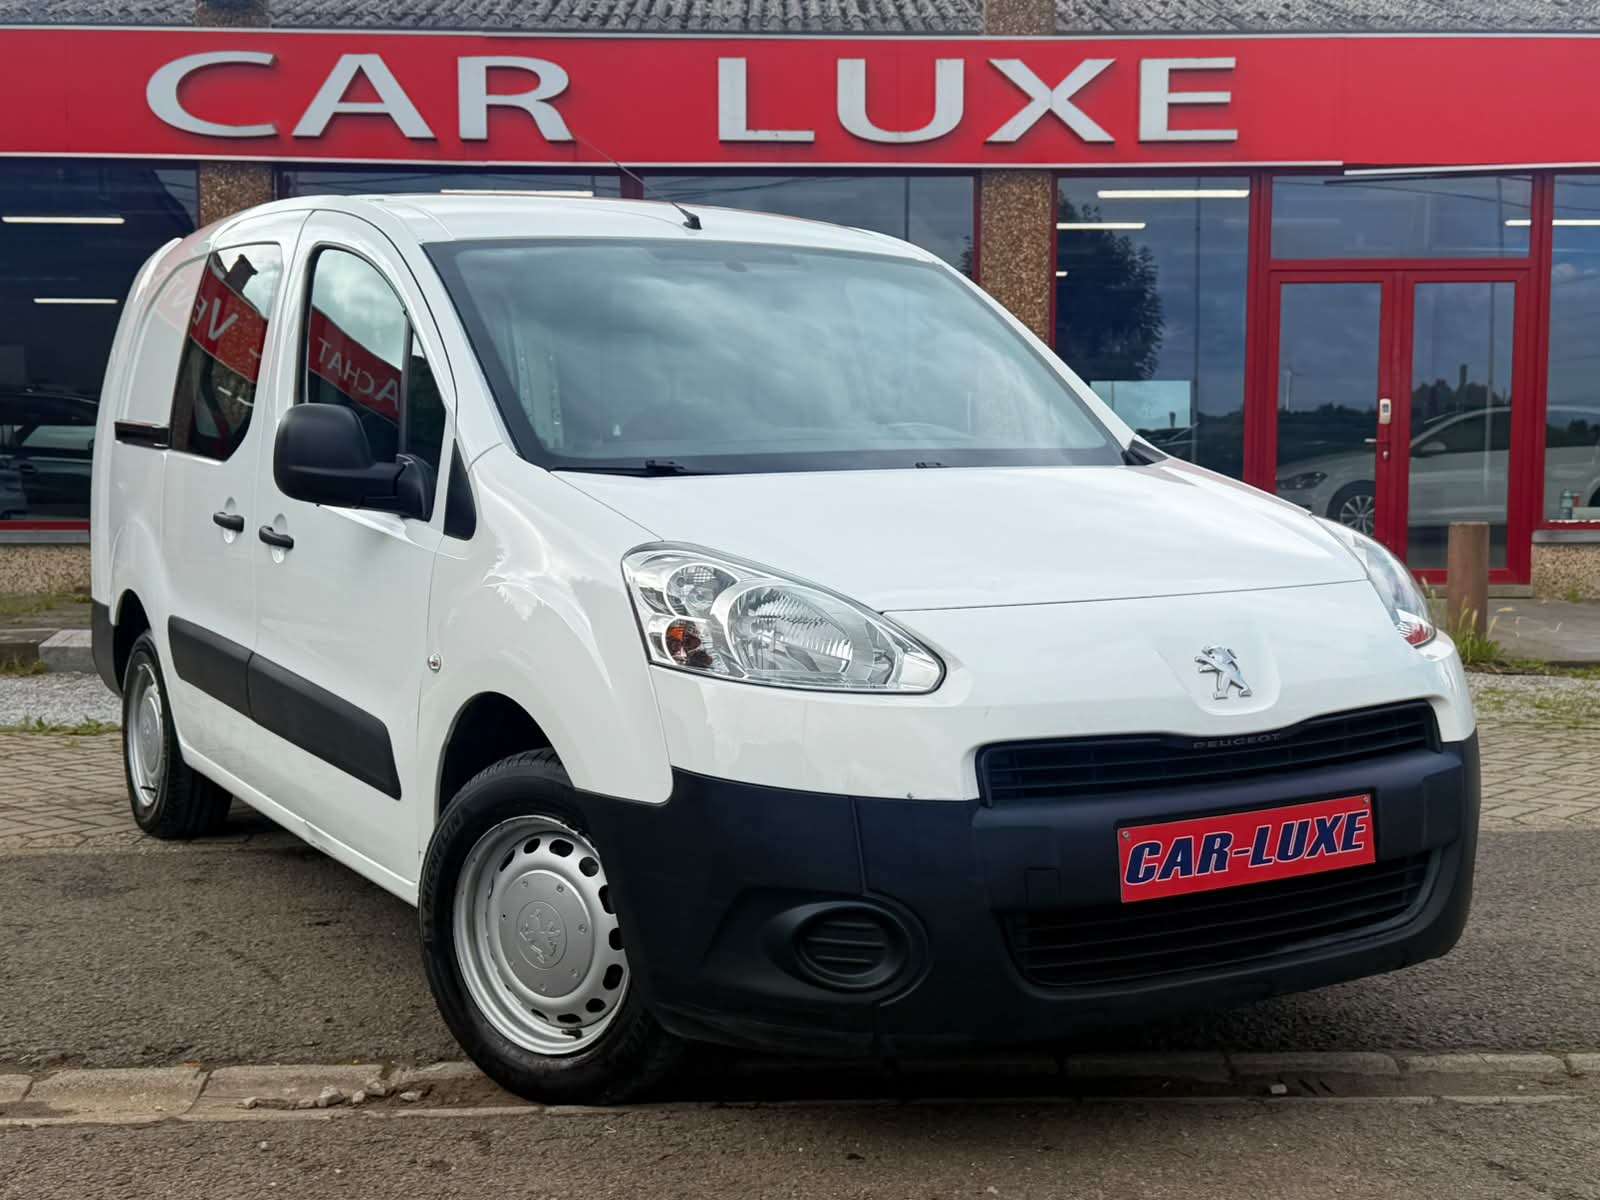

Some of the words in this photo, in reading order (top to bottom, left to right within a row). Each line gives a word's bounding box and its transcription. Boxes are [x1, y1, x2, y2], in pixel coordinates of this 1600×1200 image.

[146, 51, 575, 142] CAR
[717, 56, 1239, 143] LUXE
[1192, 732, 1281, 750] PEUGEOT
[1124, 809, 1370, 886] CAR-LUXE
